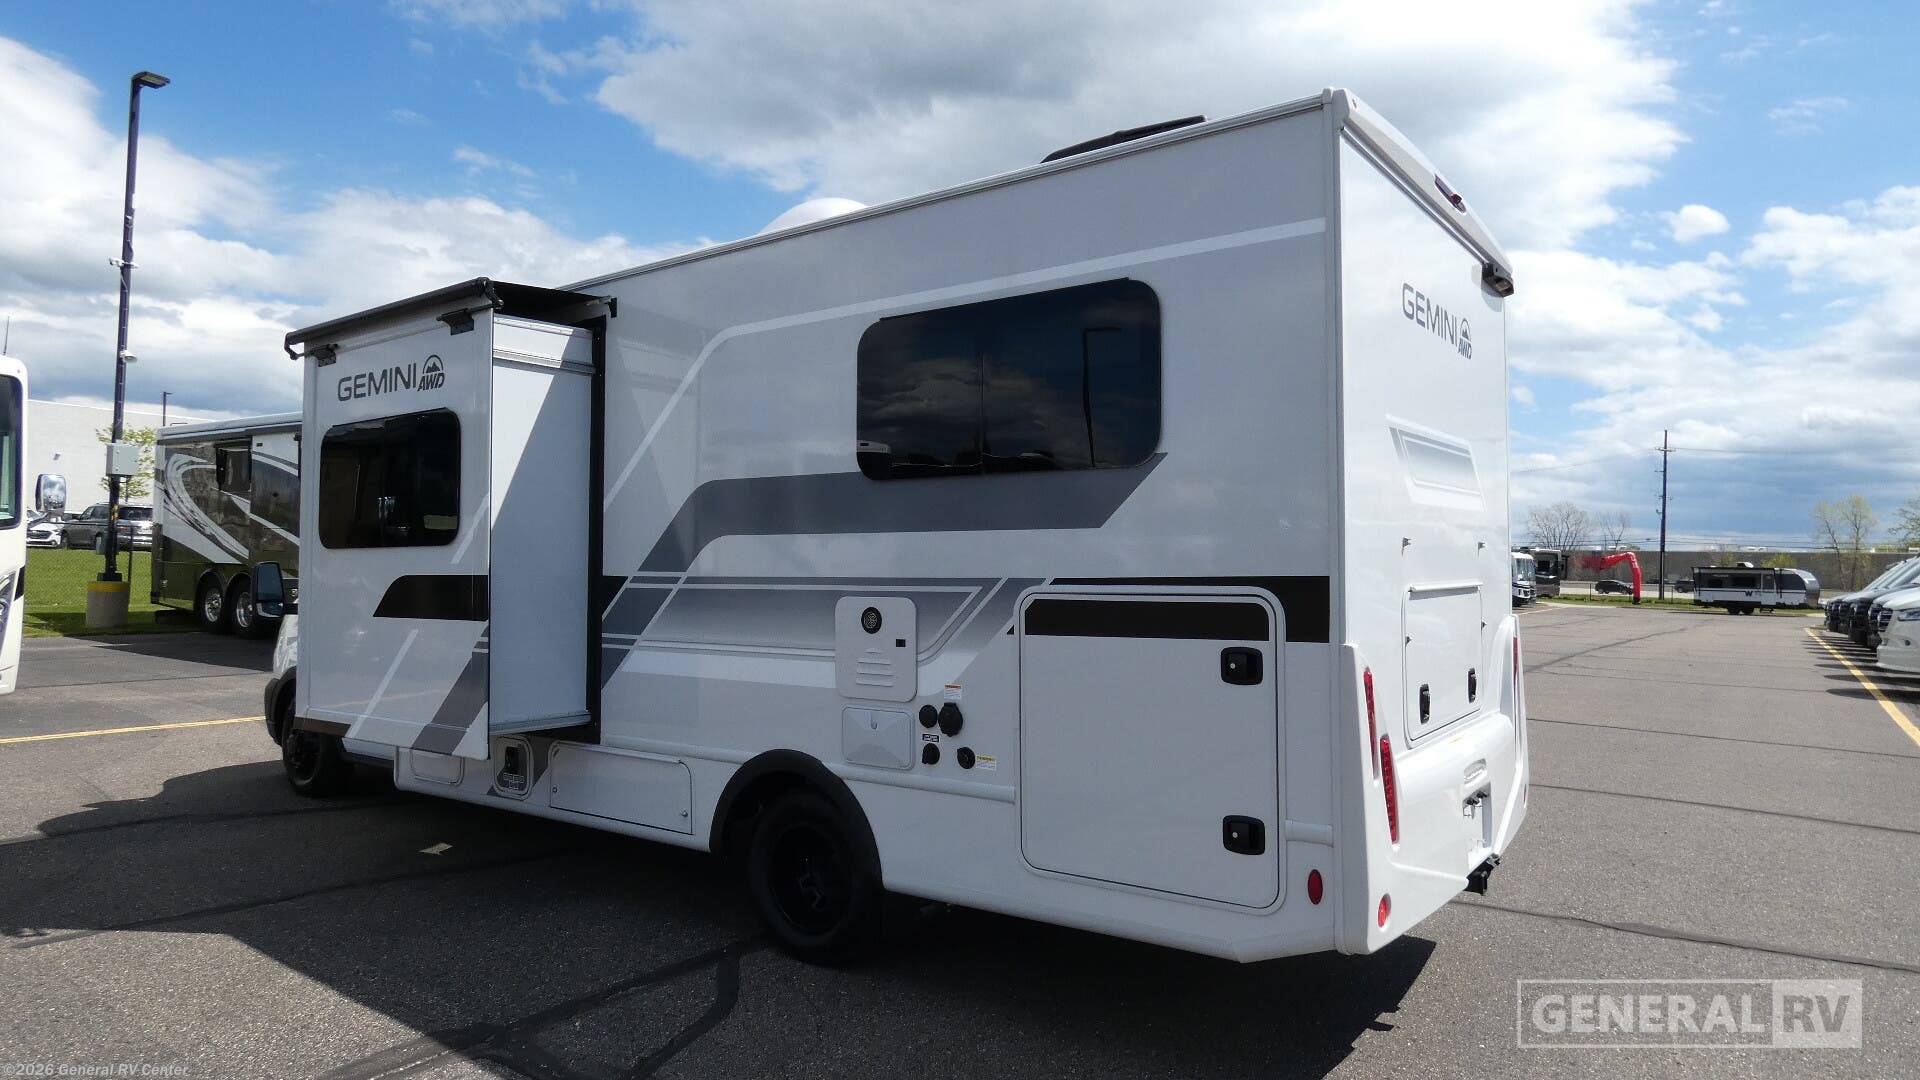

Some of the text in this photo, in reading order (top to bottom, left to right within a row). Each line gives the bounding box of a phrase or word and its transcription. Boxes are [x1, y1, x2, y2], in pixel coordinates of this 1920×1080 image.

[1402, 282, 1473, 360] GEMINI AWD
[337, 362, 445, 402] GEMINI AWD
